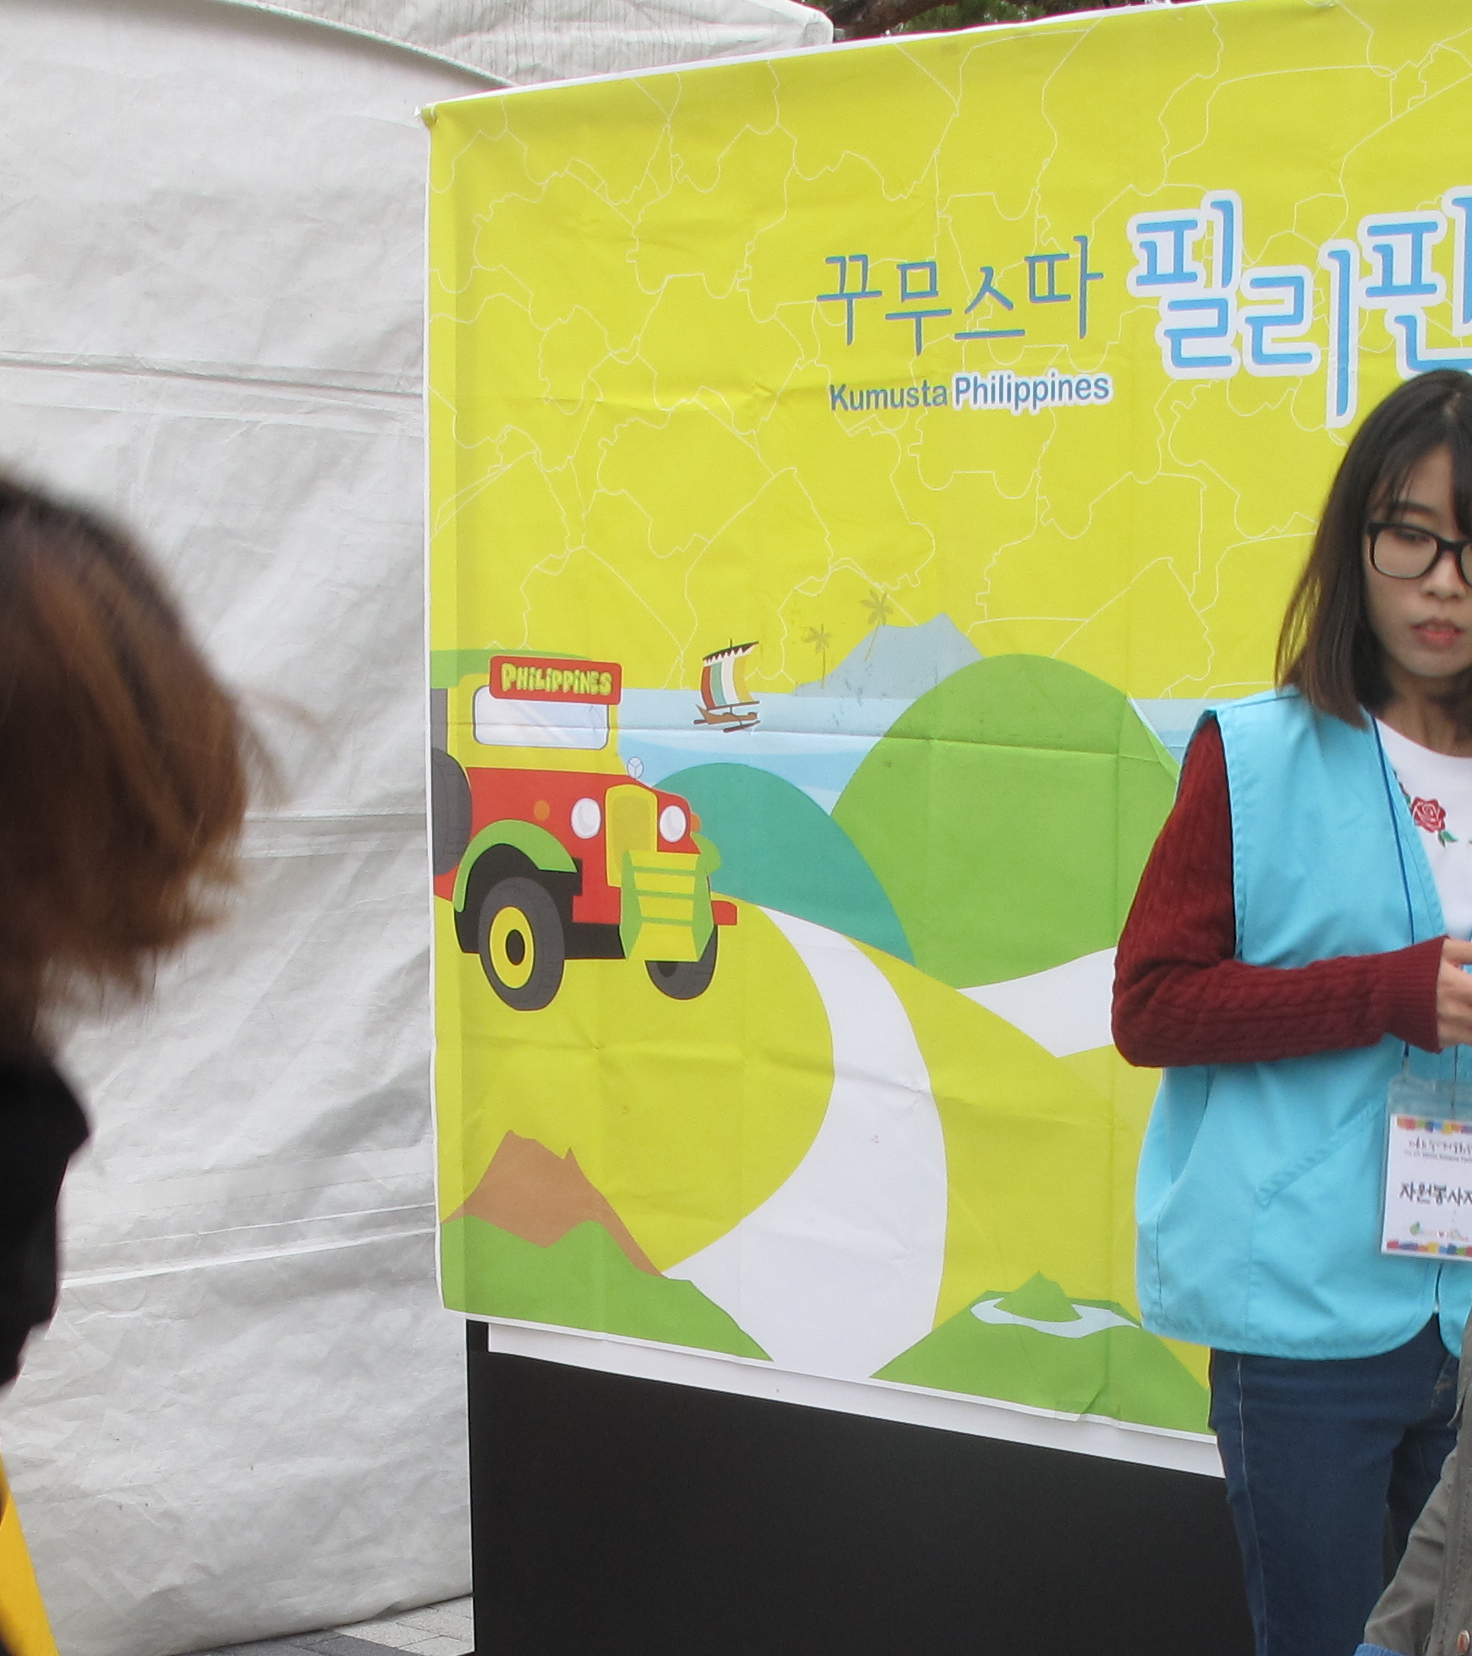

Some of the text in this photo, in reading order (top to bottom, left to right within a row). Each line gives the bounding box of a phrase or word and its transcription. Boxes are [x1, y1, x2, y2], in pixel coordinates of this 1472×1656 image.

[817, 235, 1105, 356] 꾸무스따
[829, 371, 1111, 412] Kumusta Philippines
